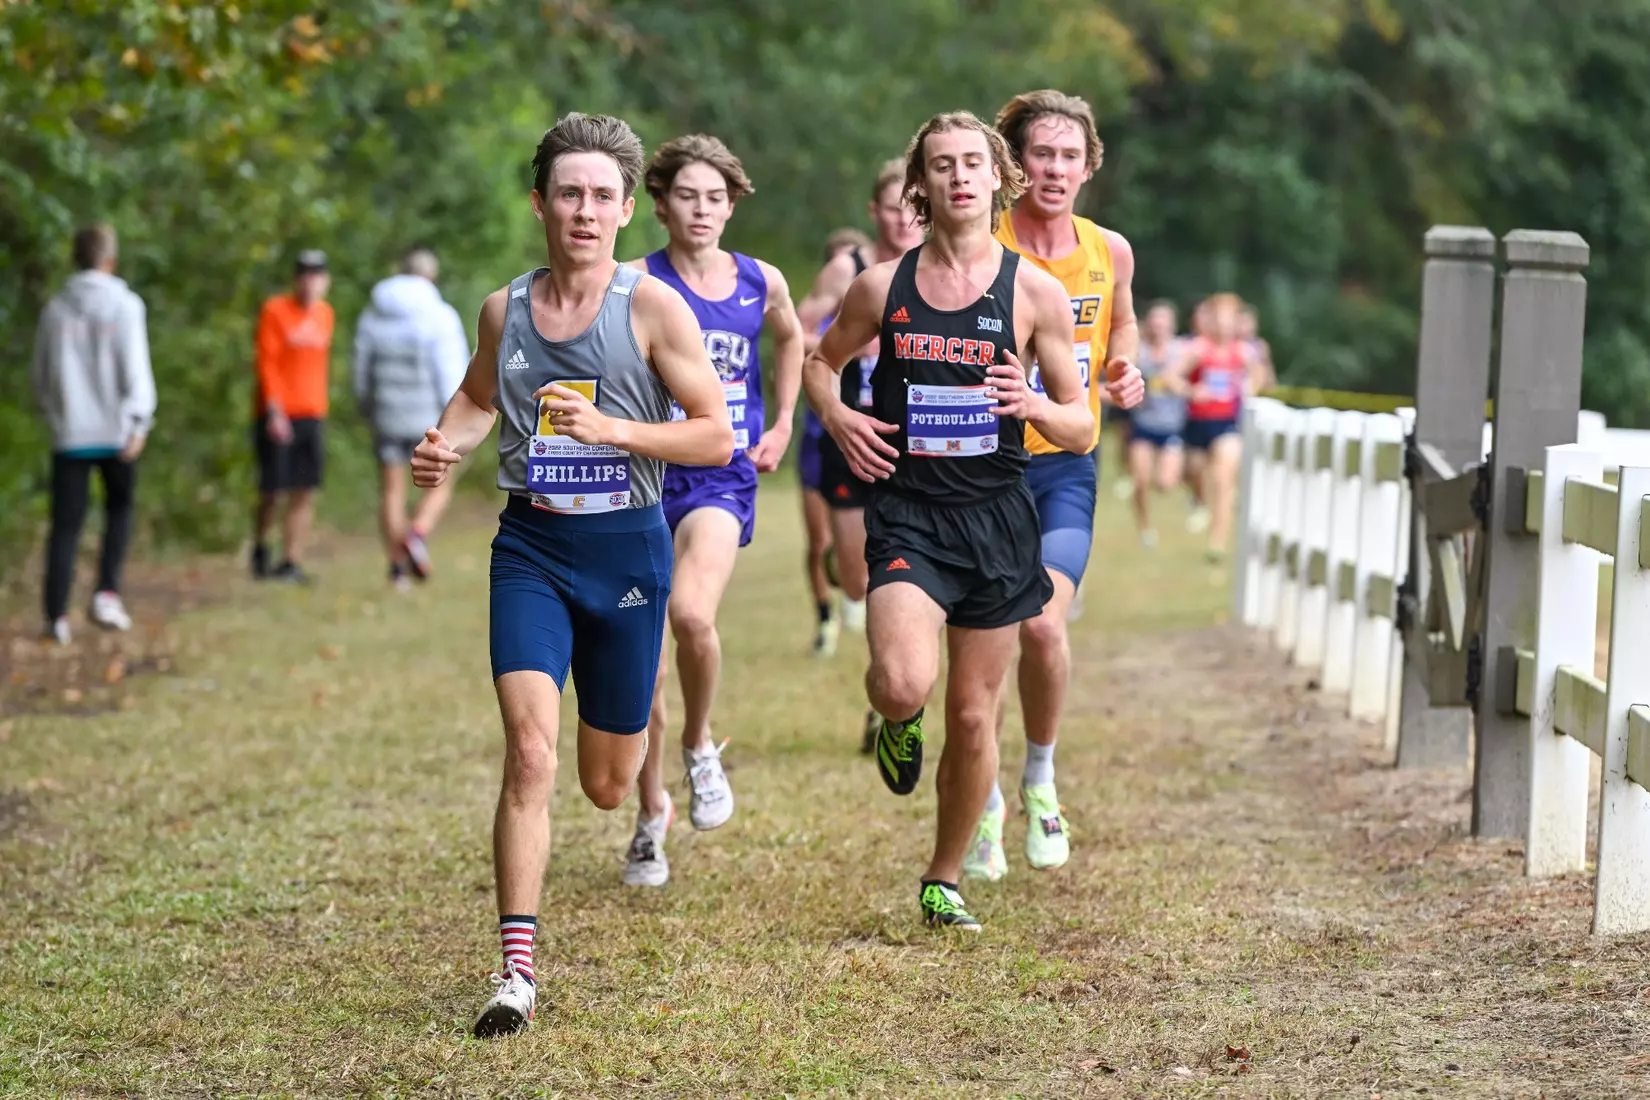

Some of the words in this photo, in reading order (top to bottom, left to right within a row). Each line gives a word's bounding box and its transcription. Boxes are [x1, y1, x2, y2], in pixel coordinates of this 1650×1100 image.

[977, 316, 1002, 333] SOCON
[701, 330, 751, 370] CU
[894, 333, 995, 365] MERCER
[505, 357, 529, 369] adidas
[911, 412, 996, 425] POTHOULAKIS
[531, 464, 627, 483] PHILLIPS
[618, 598, 648, 609] adidas
